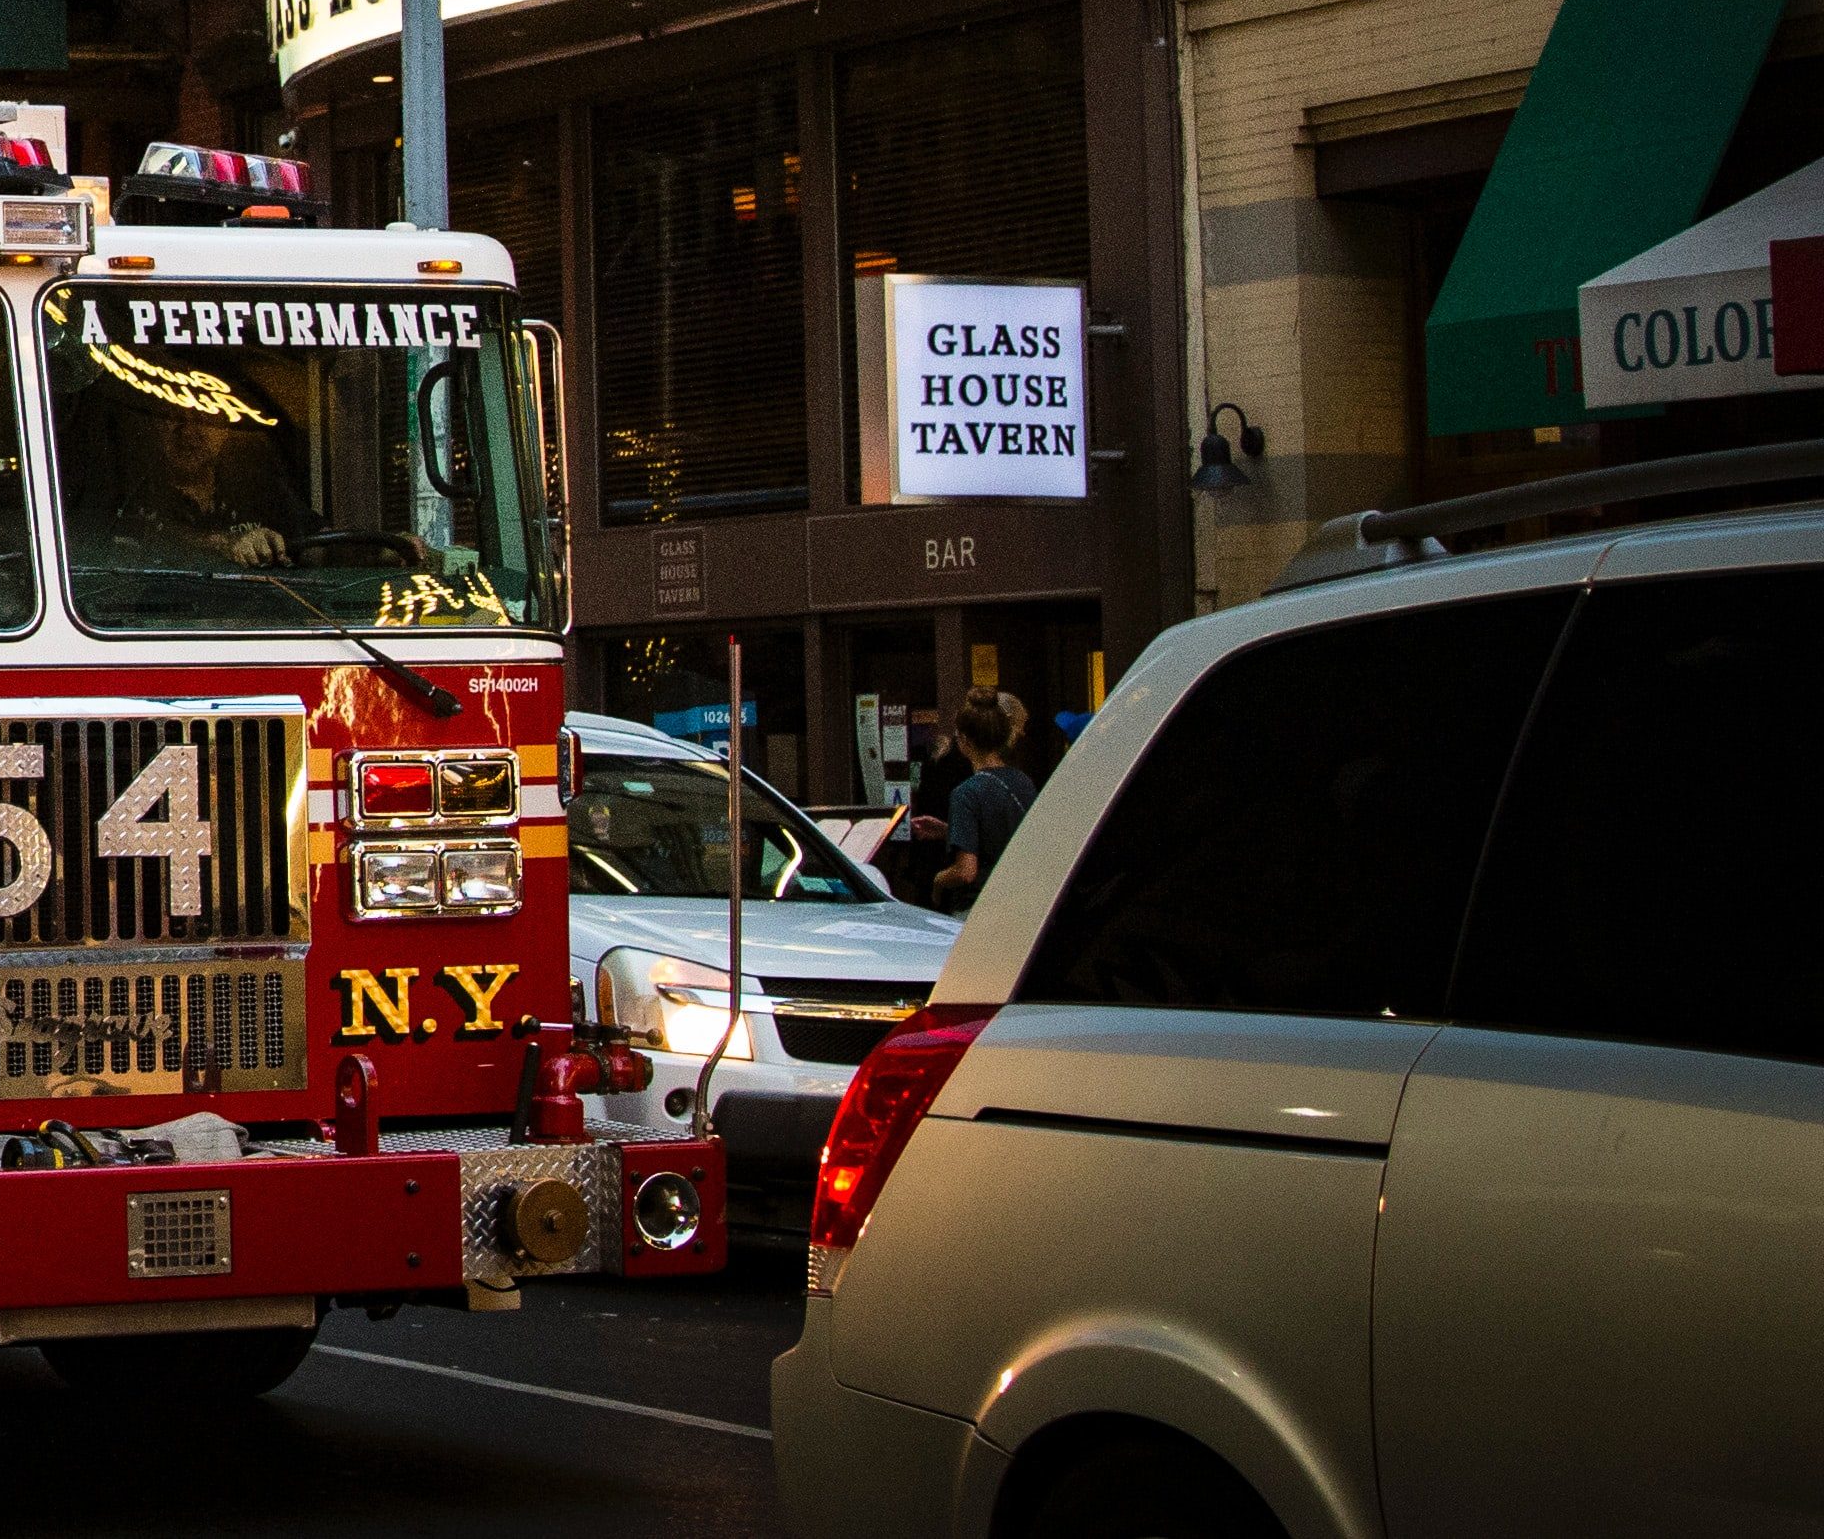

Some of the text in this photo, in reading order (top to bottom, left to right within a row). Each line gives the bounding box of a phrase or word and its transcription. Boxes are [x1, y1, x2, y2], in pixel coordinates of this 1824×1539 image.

[81, 300, 108, 344] A
[129, 300, 482, 349] PERFORMANCE
[928, 323, 1062, 359] GLASS
[921, 373, 1069, 408] HOUSE
[911, 422, 1077, 457] TAVERN
[660, 539, 696, 557] GLASS
[925, 536, 977, 570] BAR
[468, 677, 538, 693] SP14002H
[703, 708, 747, 724] 10265
[340, 964, 534, 1037] N.Y.
